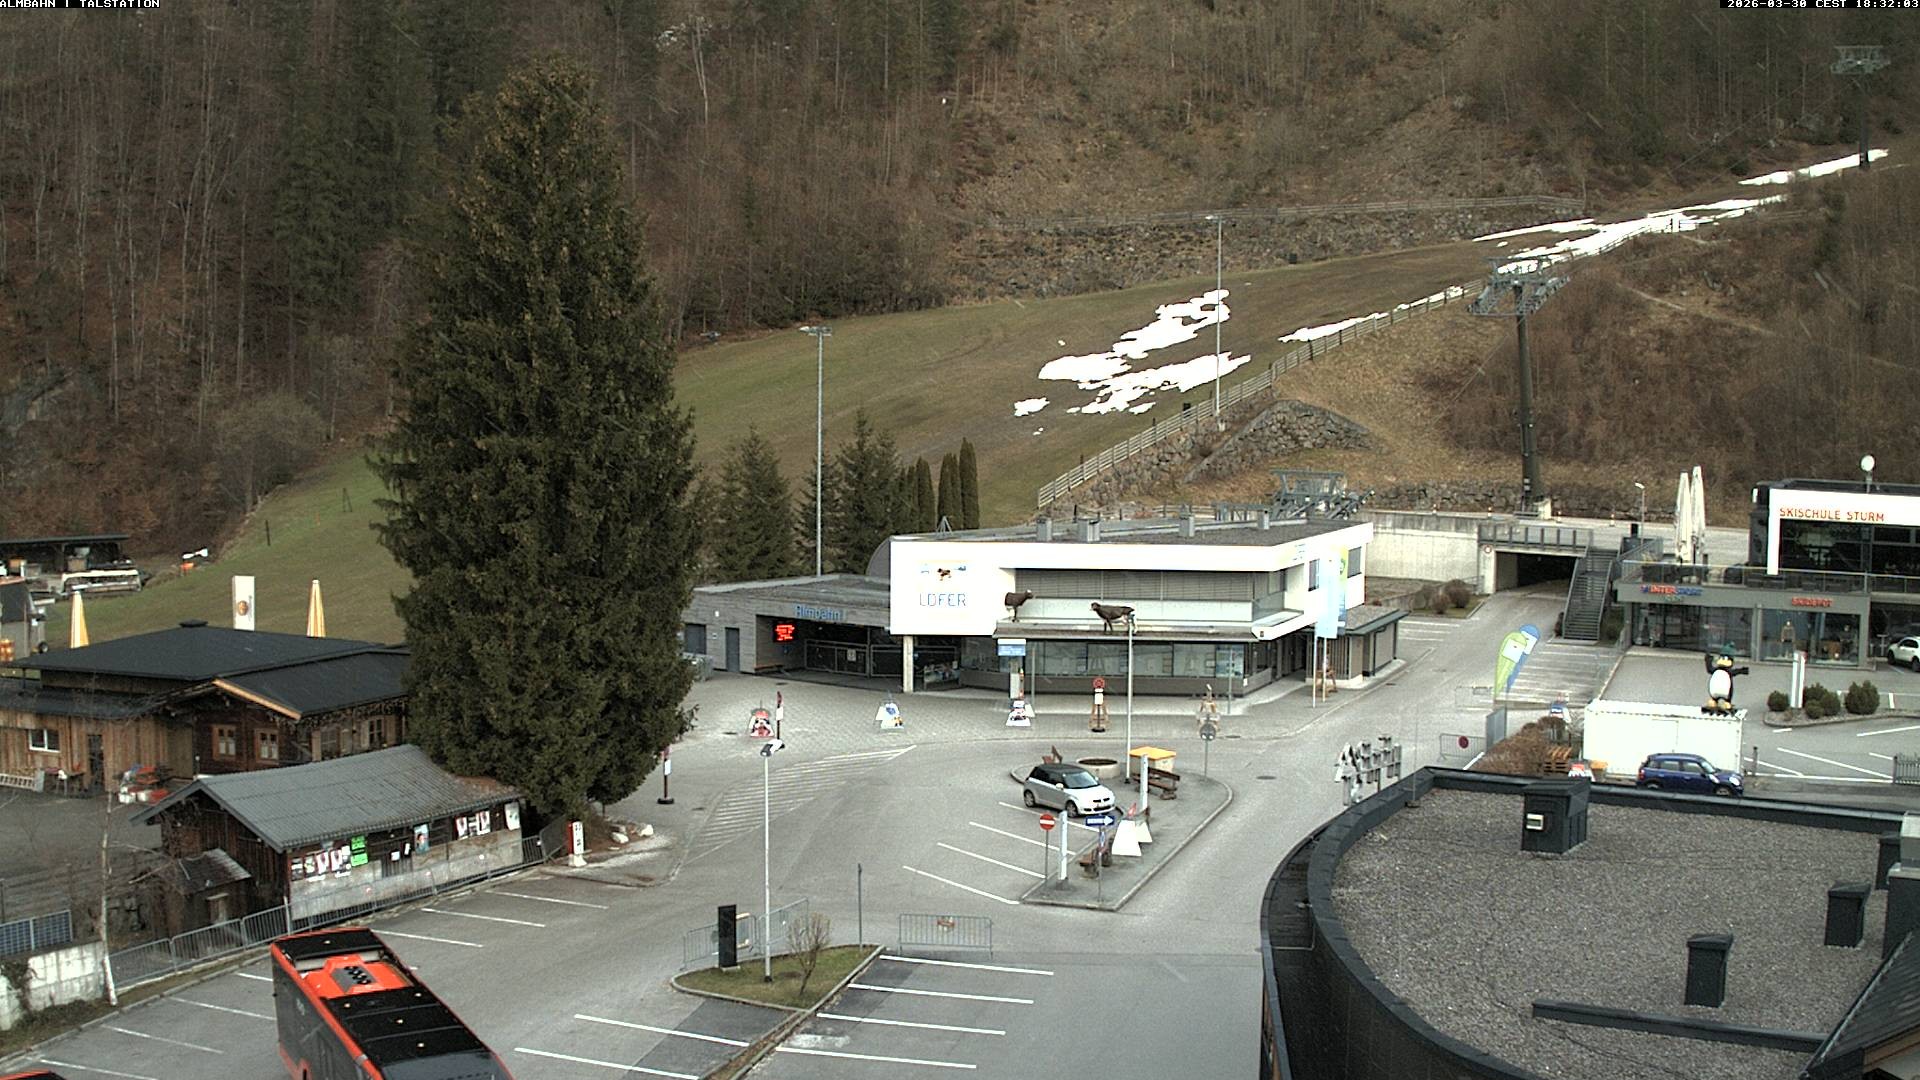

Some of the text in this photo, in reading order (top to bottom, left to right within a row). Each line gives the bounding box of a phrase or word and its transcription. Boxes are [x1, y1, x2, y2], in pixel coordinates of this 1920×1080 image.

[1779, 508, 1885, 522] SKISCHULE STURM
[919, 593, 966, 607] LOFER
